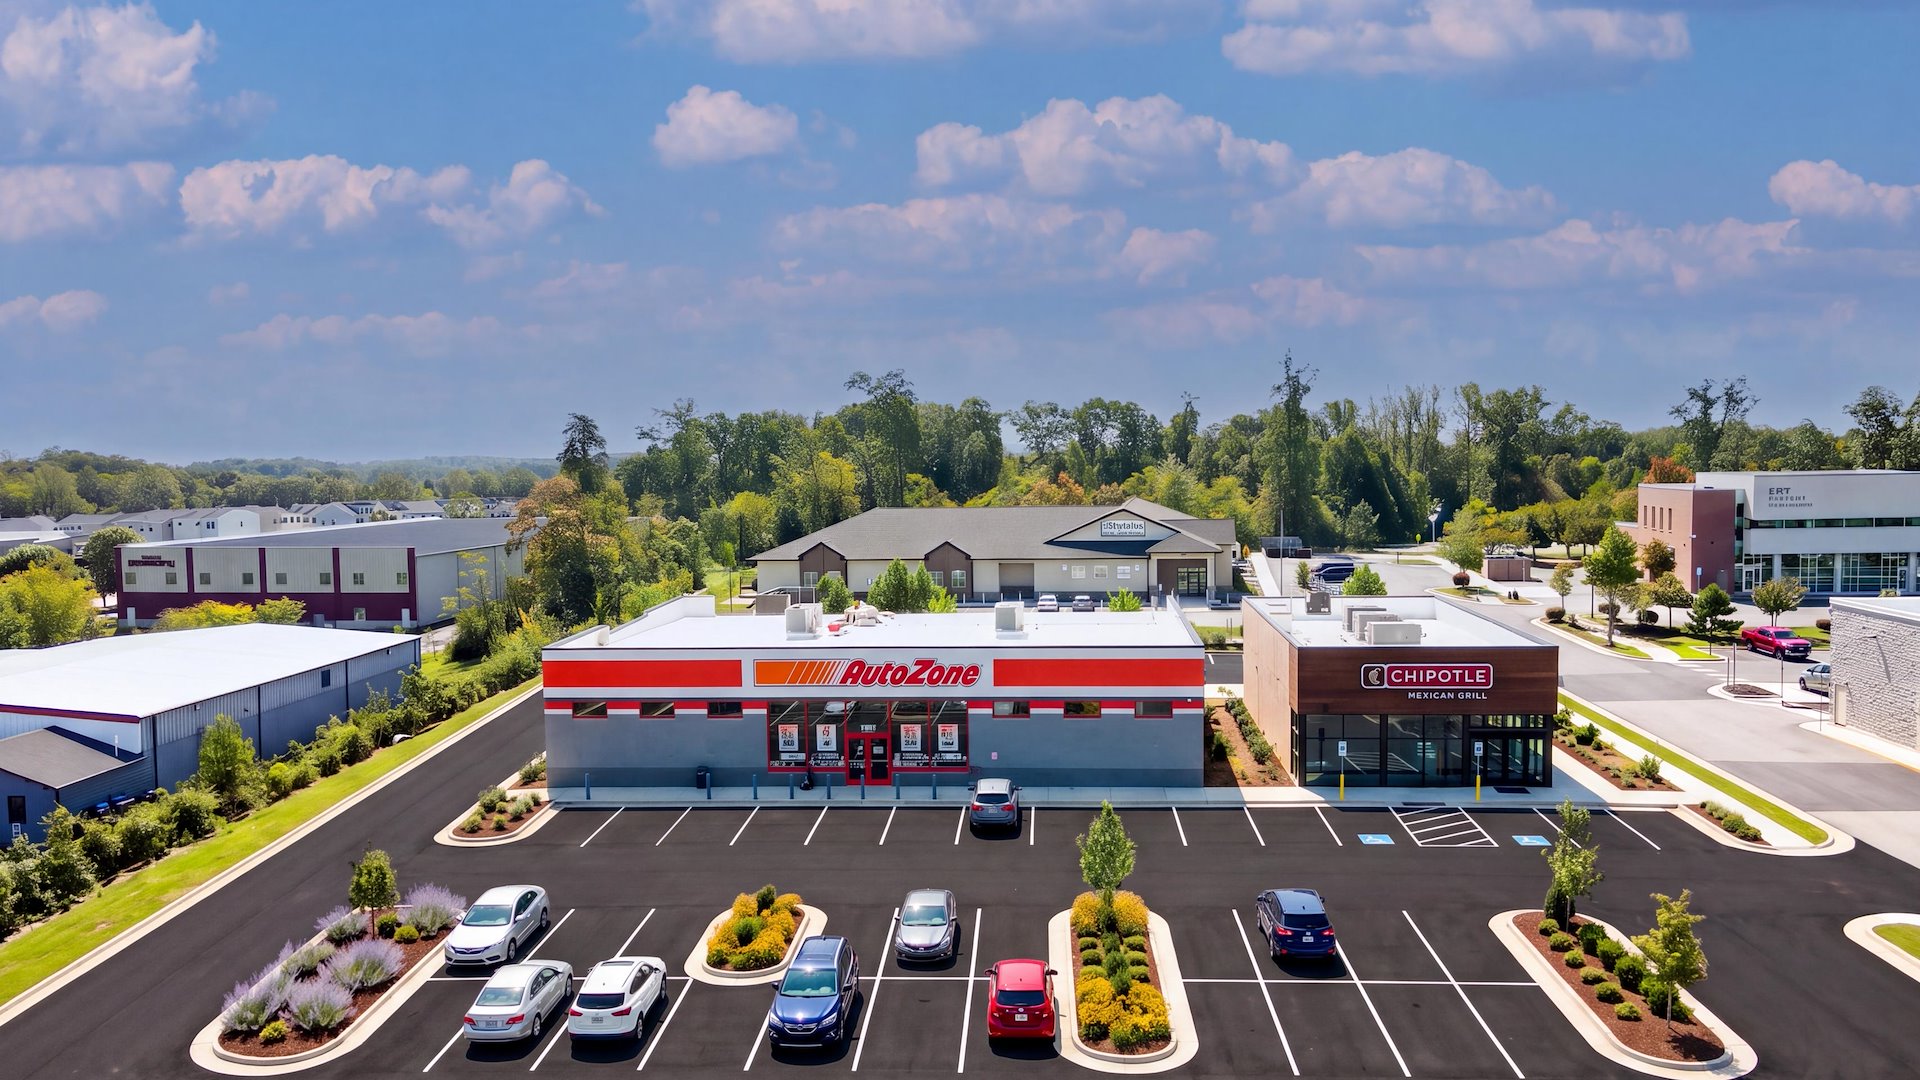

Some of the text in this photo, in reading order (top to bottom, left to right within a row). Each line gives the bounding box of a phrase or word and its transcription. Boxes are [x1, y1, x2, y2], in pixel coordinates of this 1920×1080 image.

[1768, 487, 1791, 495] ERT
[838, 658, 982, 687] AutoZone
[1390, 669, 1487, 683] CHIPOTLE
[1407, 691, 1488, 700] MEXICAN GRILL
